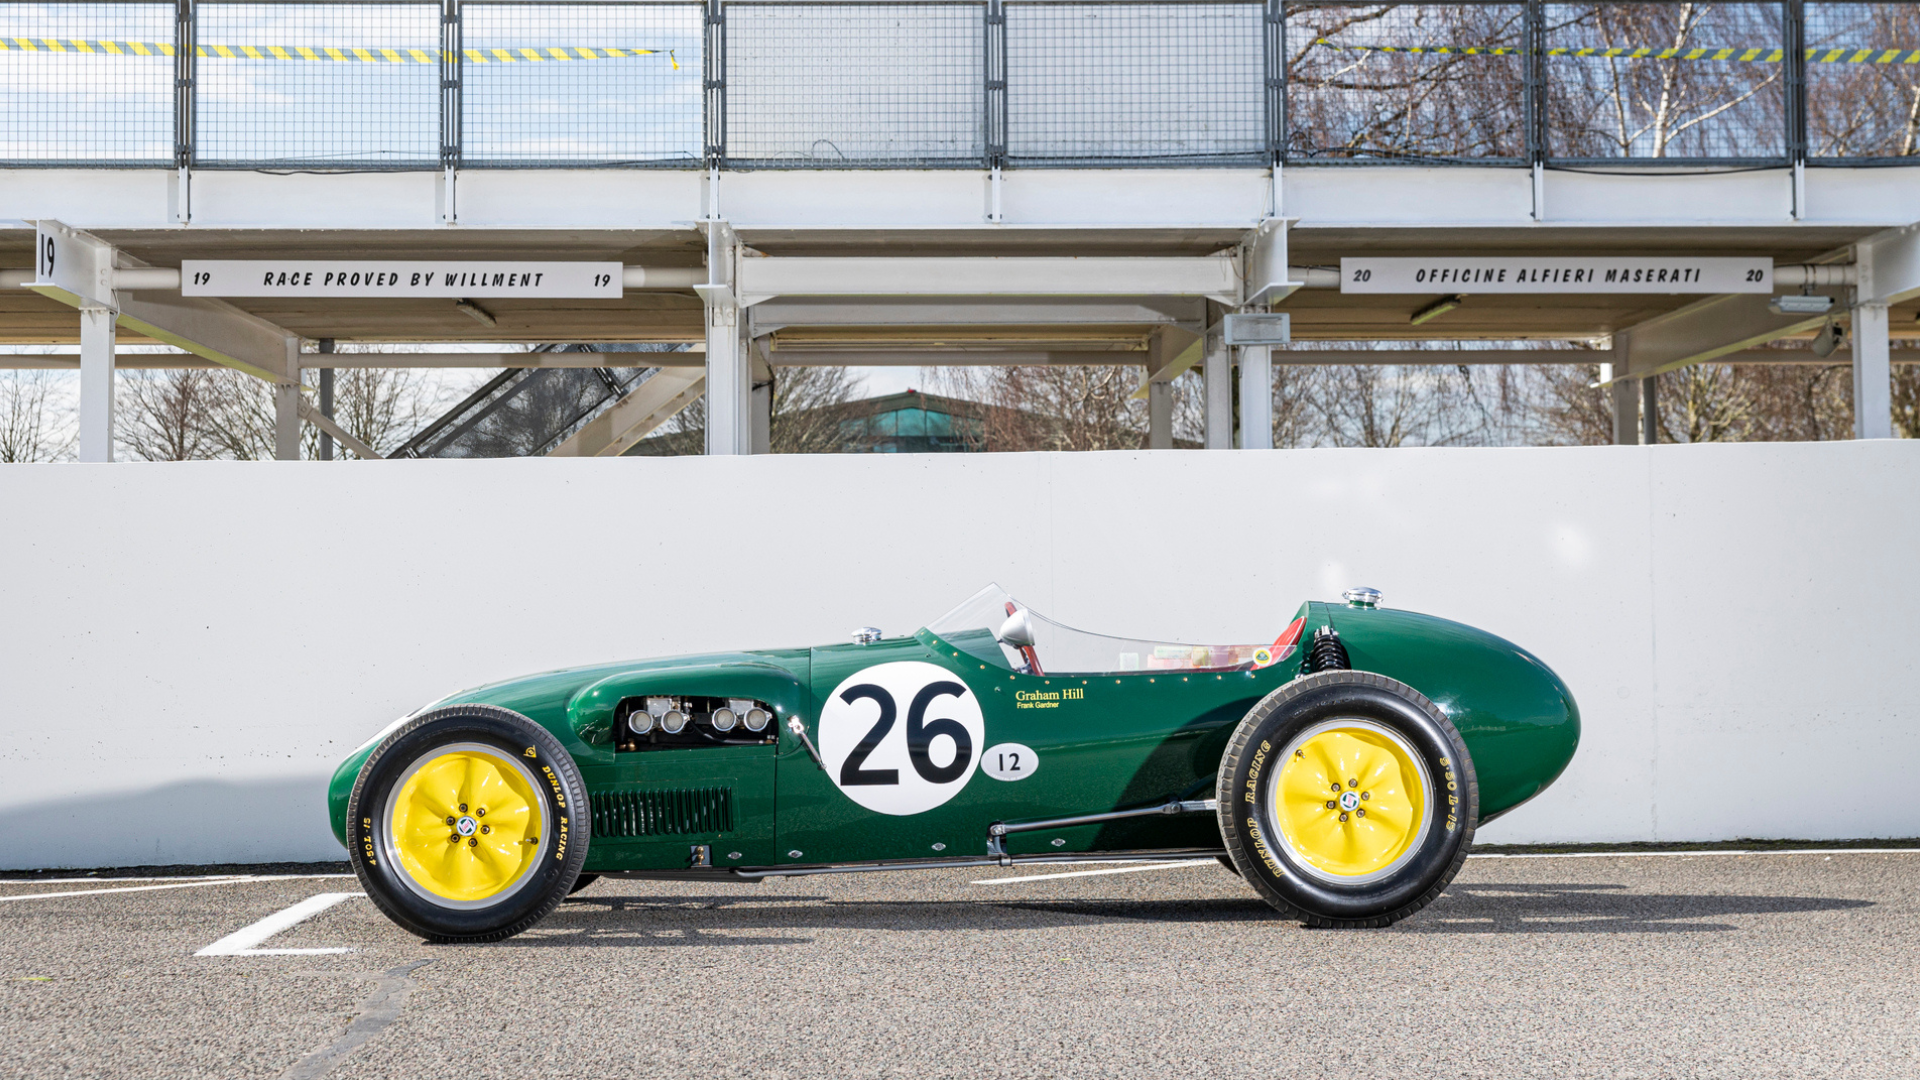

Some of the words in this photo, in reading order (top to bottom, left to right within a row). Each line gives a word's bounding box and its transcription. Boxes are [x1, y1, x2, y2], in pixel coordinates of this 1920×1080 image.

[41, 233, 55, 278] 19
[193, 272, 211, 286] 19
[263, 272, 313, 286] RACE
[324, 272, 399, 287] PROVED
[410, 272, 435, 287] BY
[444, 272, 544, 287] WILLMENT
[594, 274, 611, 287] 19
[1353, 269, 1372, 282] 20
[1415, 268, 1507, 283] OFFICINE
[1516, 268, 1594, 283] ALFIERI
[1604, 268, 1701, 283] MASERATI
[1745, 269, 1764, 282] 20
[1015, 690, 1060, 701] Graham
[1062, 688, 1084, 700] Hill
[1035, 701, 1060, 709] Gardner
[839, 680, 973, 786] 26
[998, 752, 1021, 772] 12
[1245, 740, 1271, 804] RACING
[542, 765, 567, 809] DUNLOP
[556, 816, 568, 861] RACING
[1246, 818, 1286, 878] DUNLOP
